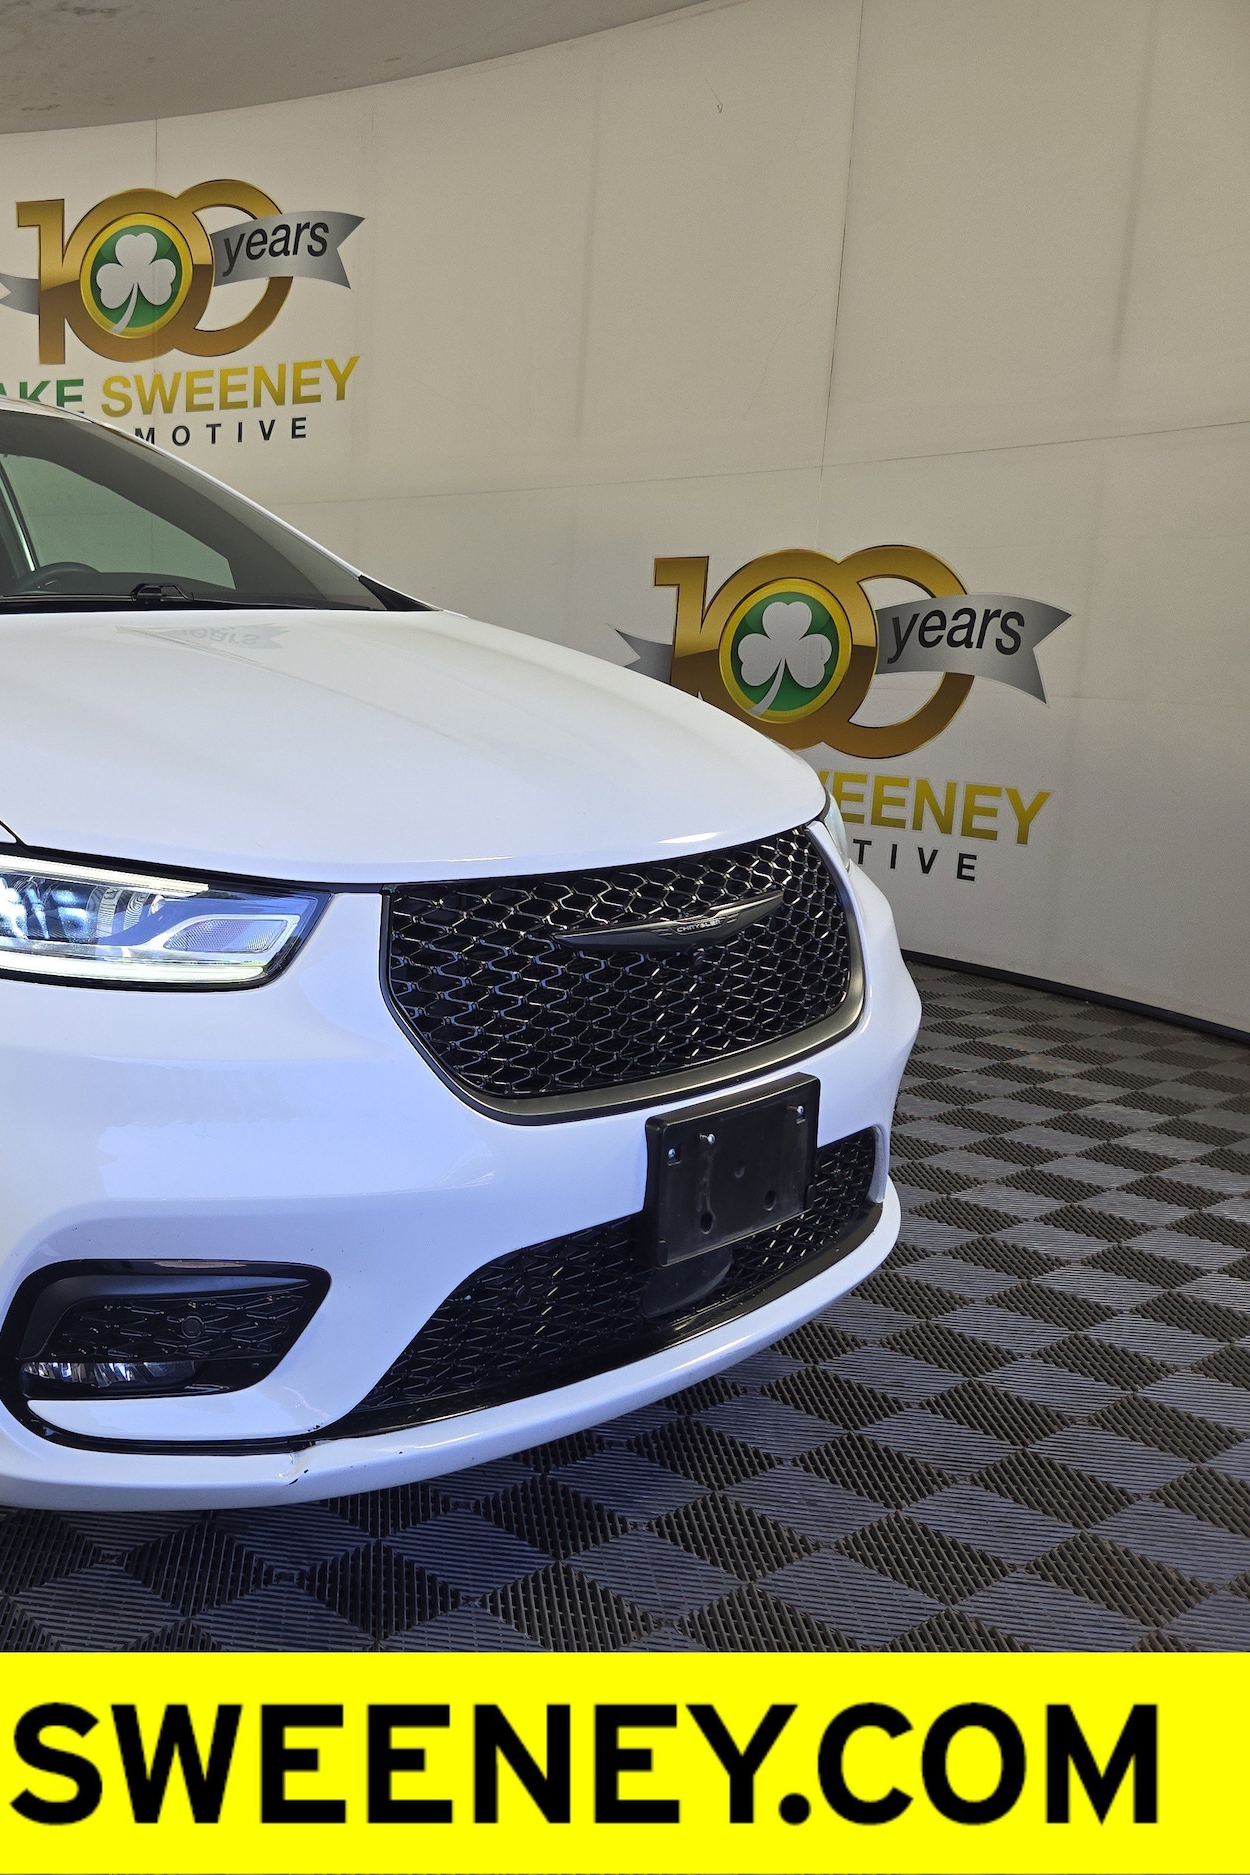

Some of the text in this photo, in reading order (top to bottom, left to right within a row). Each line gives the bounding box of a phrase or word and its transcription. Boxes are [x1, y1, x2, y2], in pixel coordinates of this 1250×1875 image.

[16, 178, 294, 365] 100
[222, 217, 330, 277] years
[101, 355, 361, 419] SWEENEY
[134, 416, 308, 447] MOTIVE
[653, 543, 976, 760] 100
[887, 607, 1026, 665] years
[817, 770, 1052, 846] EENEY
[852, 838, 978, 882] TIVE
